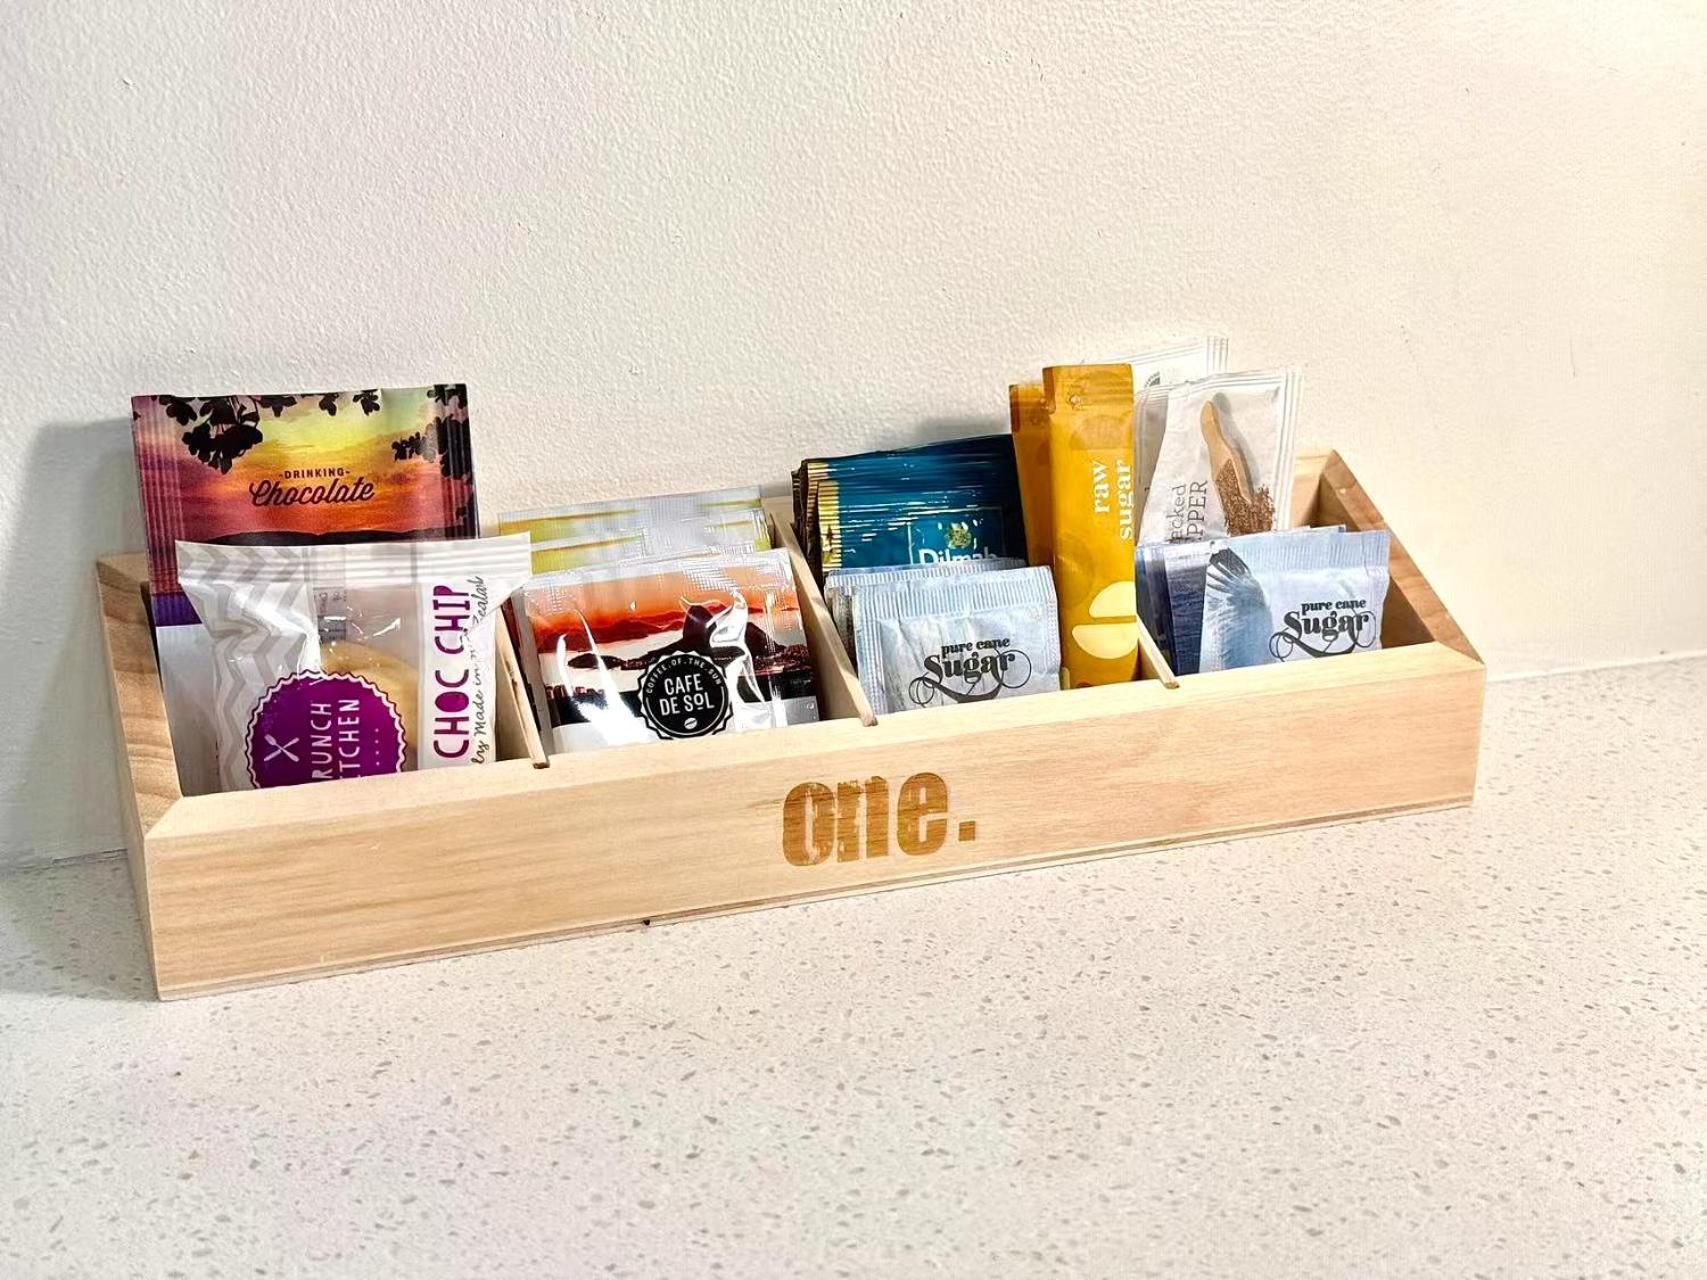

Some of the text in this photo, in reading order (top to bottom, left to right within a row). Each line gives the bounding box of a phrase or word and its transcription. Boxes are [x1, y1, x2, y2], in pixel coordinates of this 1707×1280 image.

[249, 476, 375, 507] Chocolate
[1092, 460, 1110, 513] raw
[1117, 459, 1135, 540] sugar
[1186, 480, 1208, 540] PPER
[1301, 598, 1366, 615] pure cane
[941, 637, 1010, 658] pure cane
[1272, 611, 1375, 658] Sugar
[432, 585, 470, 758] CHOC CHIP
[646, 664, 667, 694] COFFEE
[671, 657, 682, 667] OF
[688, 657, 705, 669] THE
[664, 673, 703, 696] CAFE
[912, 651, 1028, 700] Sugar
[473, 689, 487, 737] Made
[660, 697, 681, 716] DE
[783, 772, 976, 867] one.
